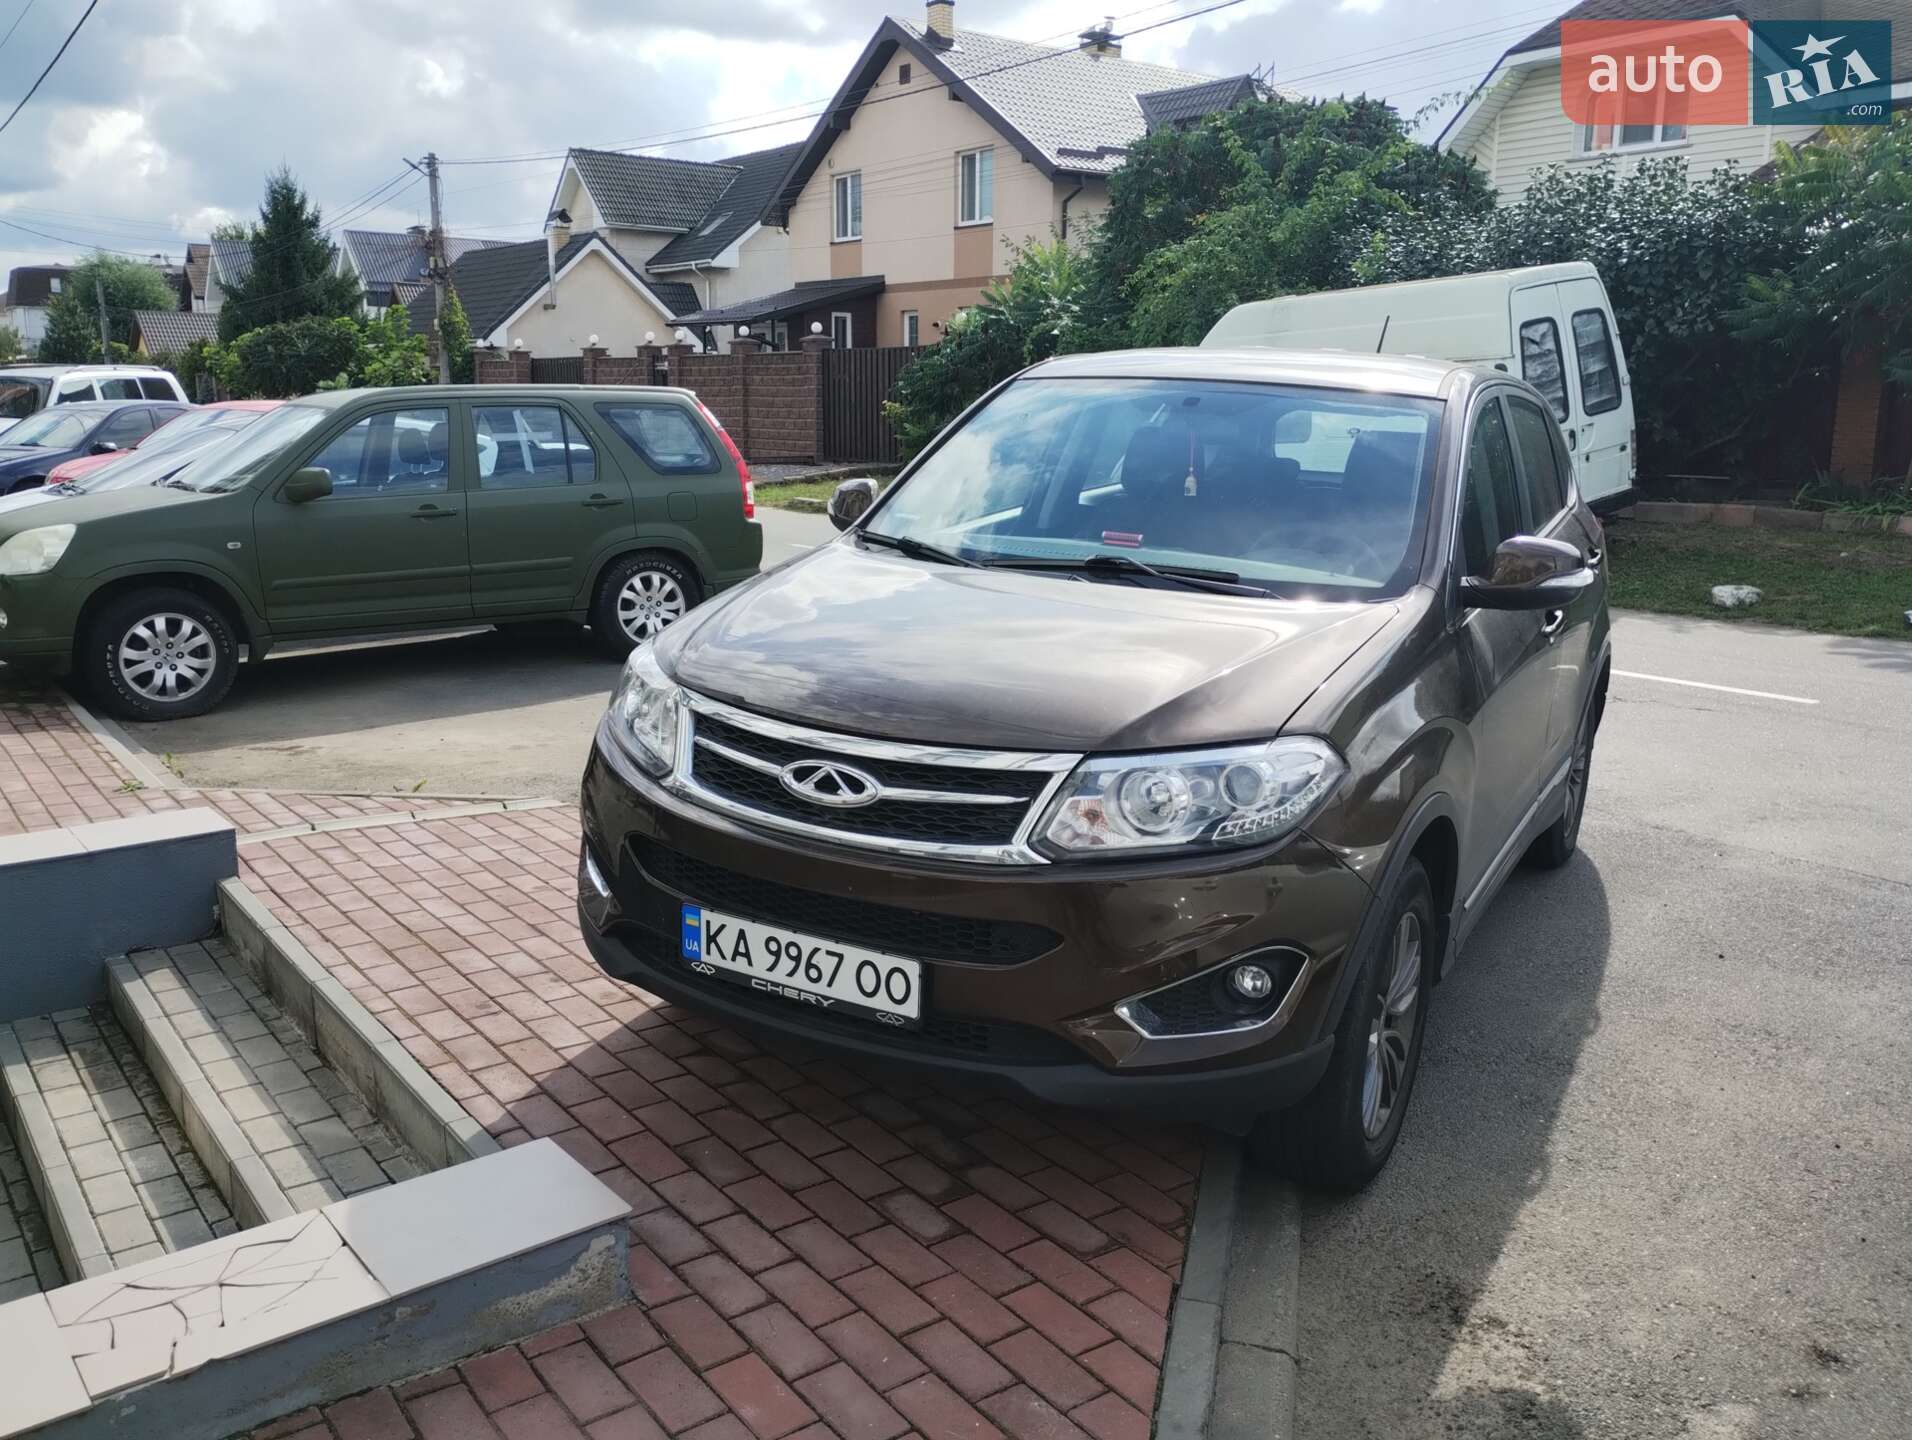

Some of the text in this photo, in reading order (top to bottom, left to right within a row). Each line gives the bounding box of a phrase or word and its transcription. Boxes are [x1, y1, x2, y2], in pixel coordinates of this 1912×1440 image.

[685, 940, 699, 952] UA
[705, 919, 753, 967] KA
[764, 936, 844, 988] 9967
[751, 978, 836, 1007] CHERY
